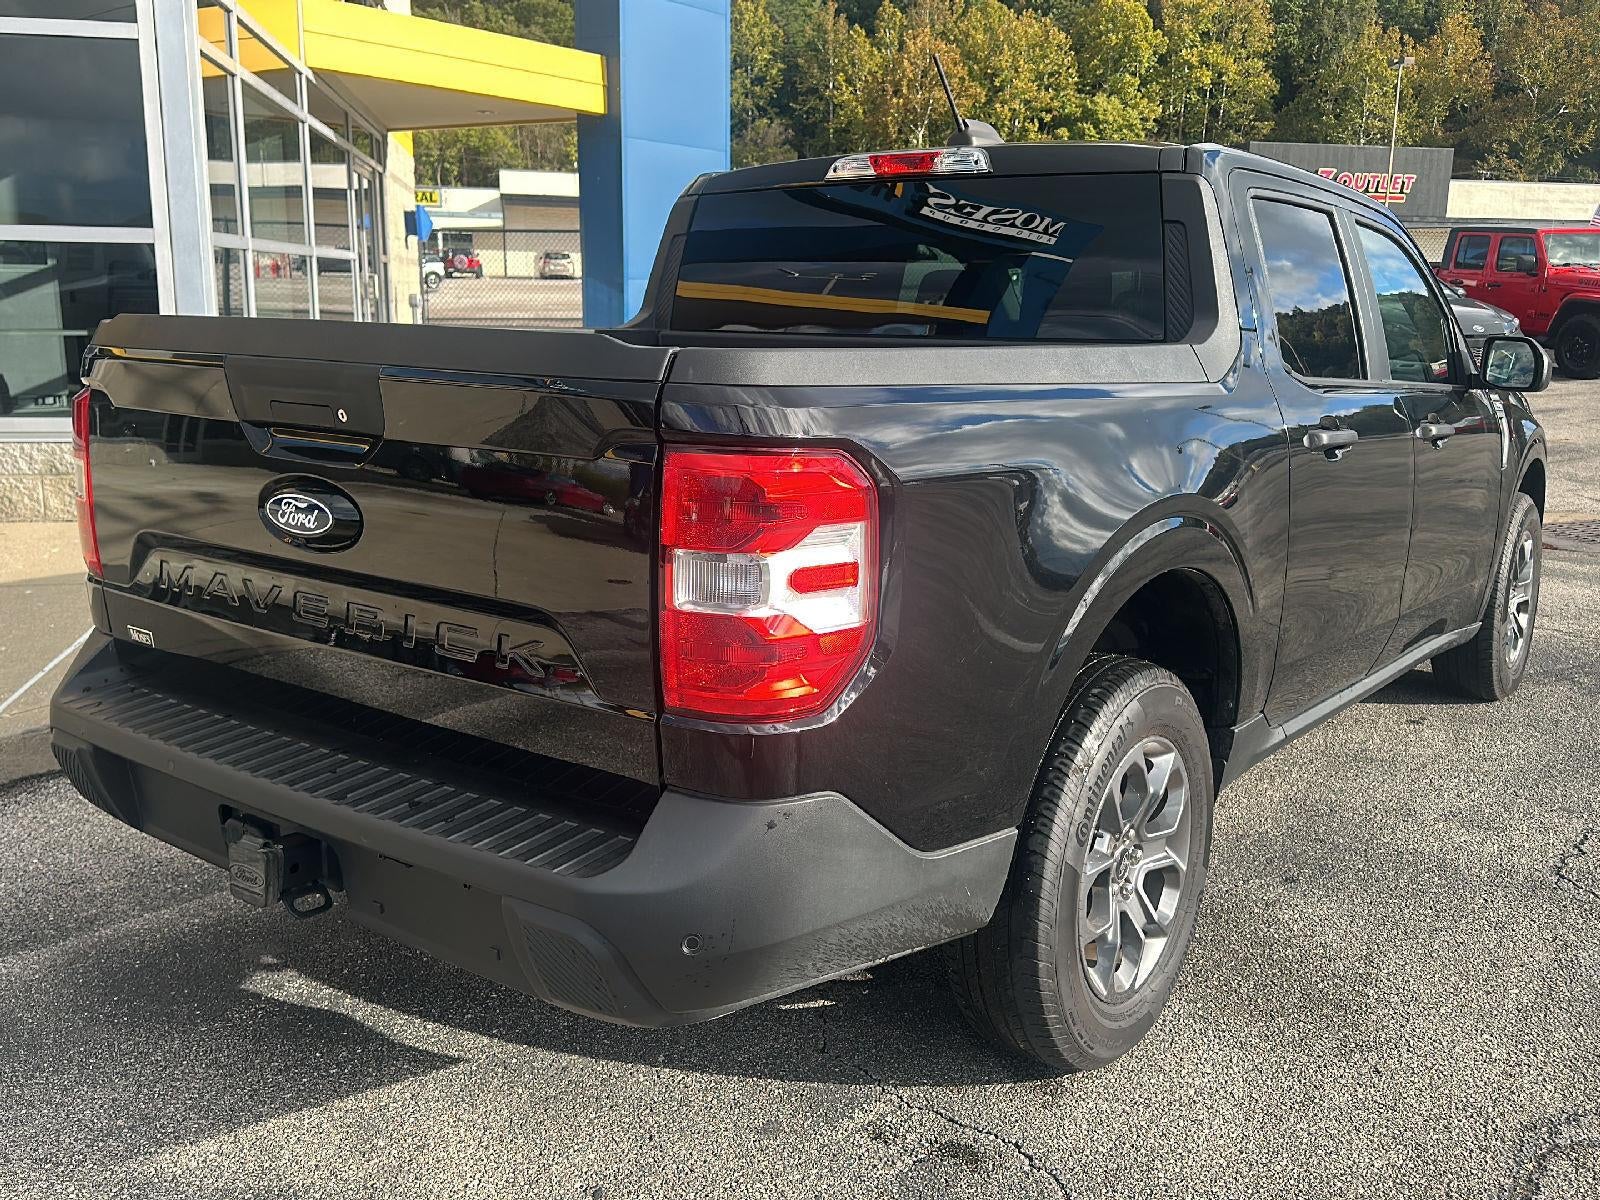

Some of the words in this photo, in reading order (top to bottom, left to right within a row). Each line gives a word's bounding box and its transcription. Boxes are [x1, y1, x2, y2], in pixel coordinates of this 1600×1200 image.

[1337, 171, 1417, 193] OUTLET
[278, 498, 319, 529] Ford
[158, 558, 546, 678] MAVERICK
[1075, 724, 1129, 848] Continental
